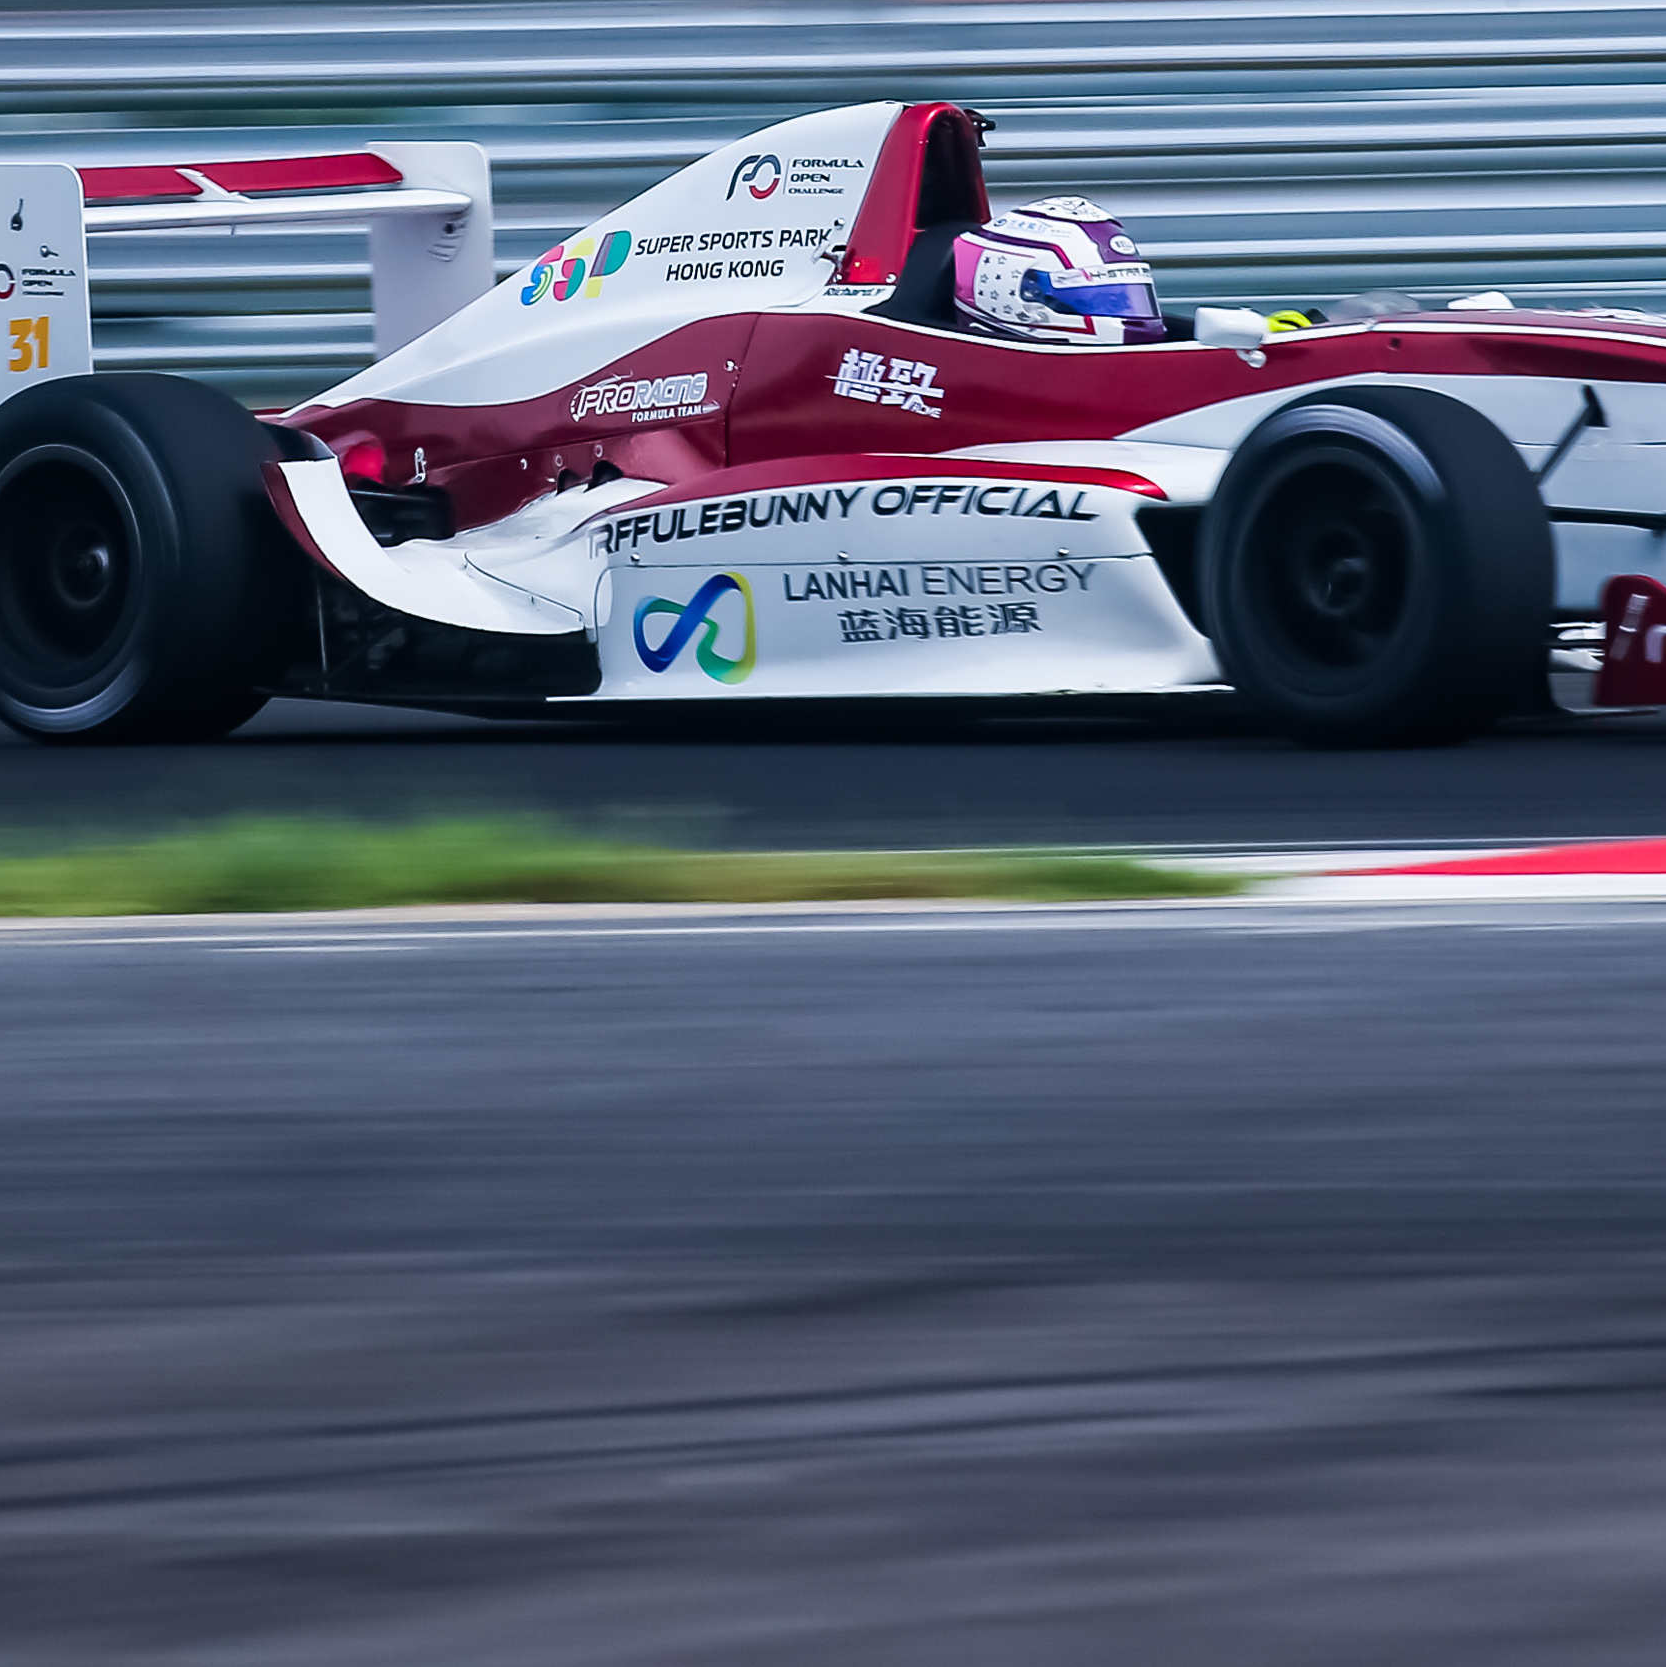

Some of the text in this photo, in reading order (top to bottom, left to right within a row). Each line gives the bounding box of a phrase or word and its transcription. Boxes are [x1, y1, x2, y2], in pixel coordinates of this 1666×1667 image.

[791, 158, 865, 168] FORMULA
[790, 173, 831, 183] OPEN
[788, 187, 845, 195] CHALLENGE
[635, 228, 833, 256] SUPER SPORTS PARK
[666, 259, 784, 281] HONG KONG
[8, 316, 50, 372] 31
[631, 405, 703, 423] FORMULA TEAM
[871, 485, 1101, 522] OFFICIAL
[783, 563, 1097, 601] LANHAI ENERGY
[837, 601, 1044, 643] 蓝海能源
